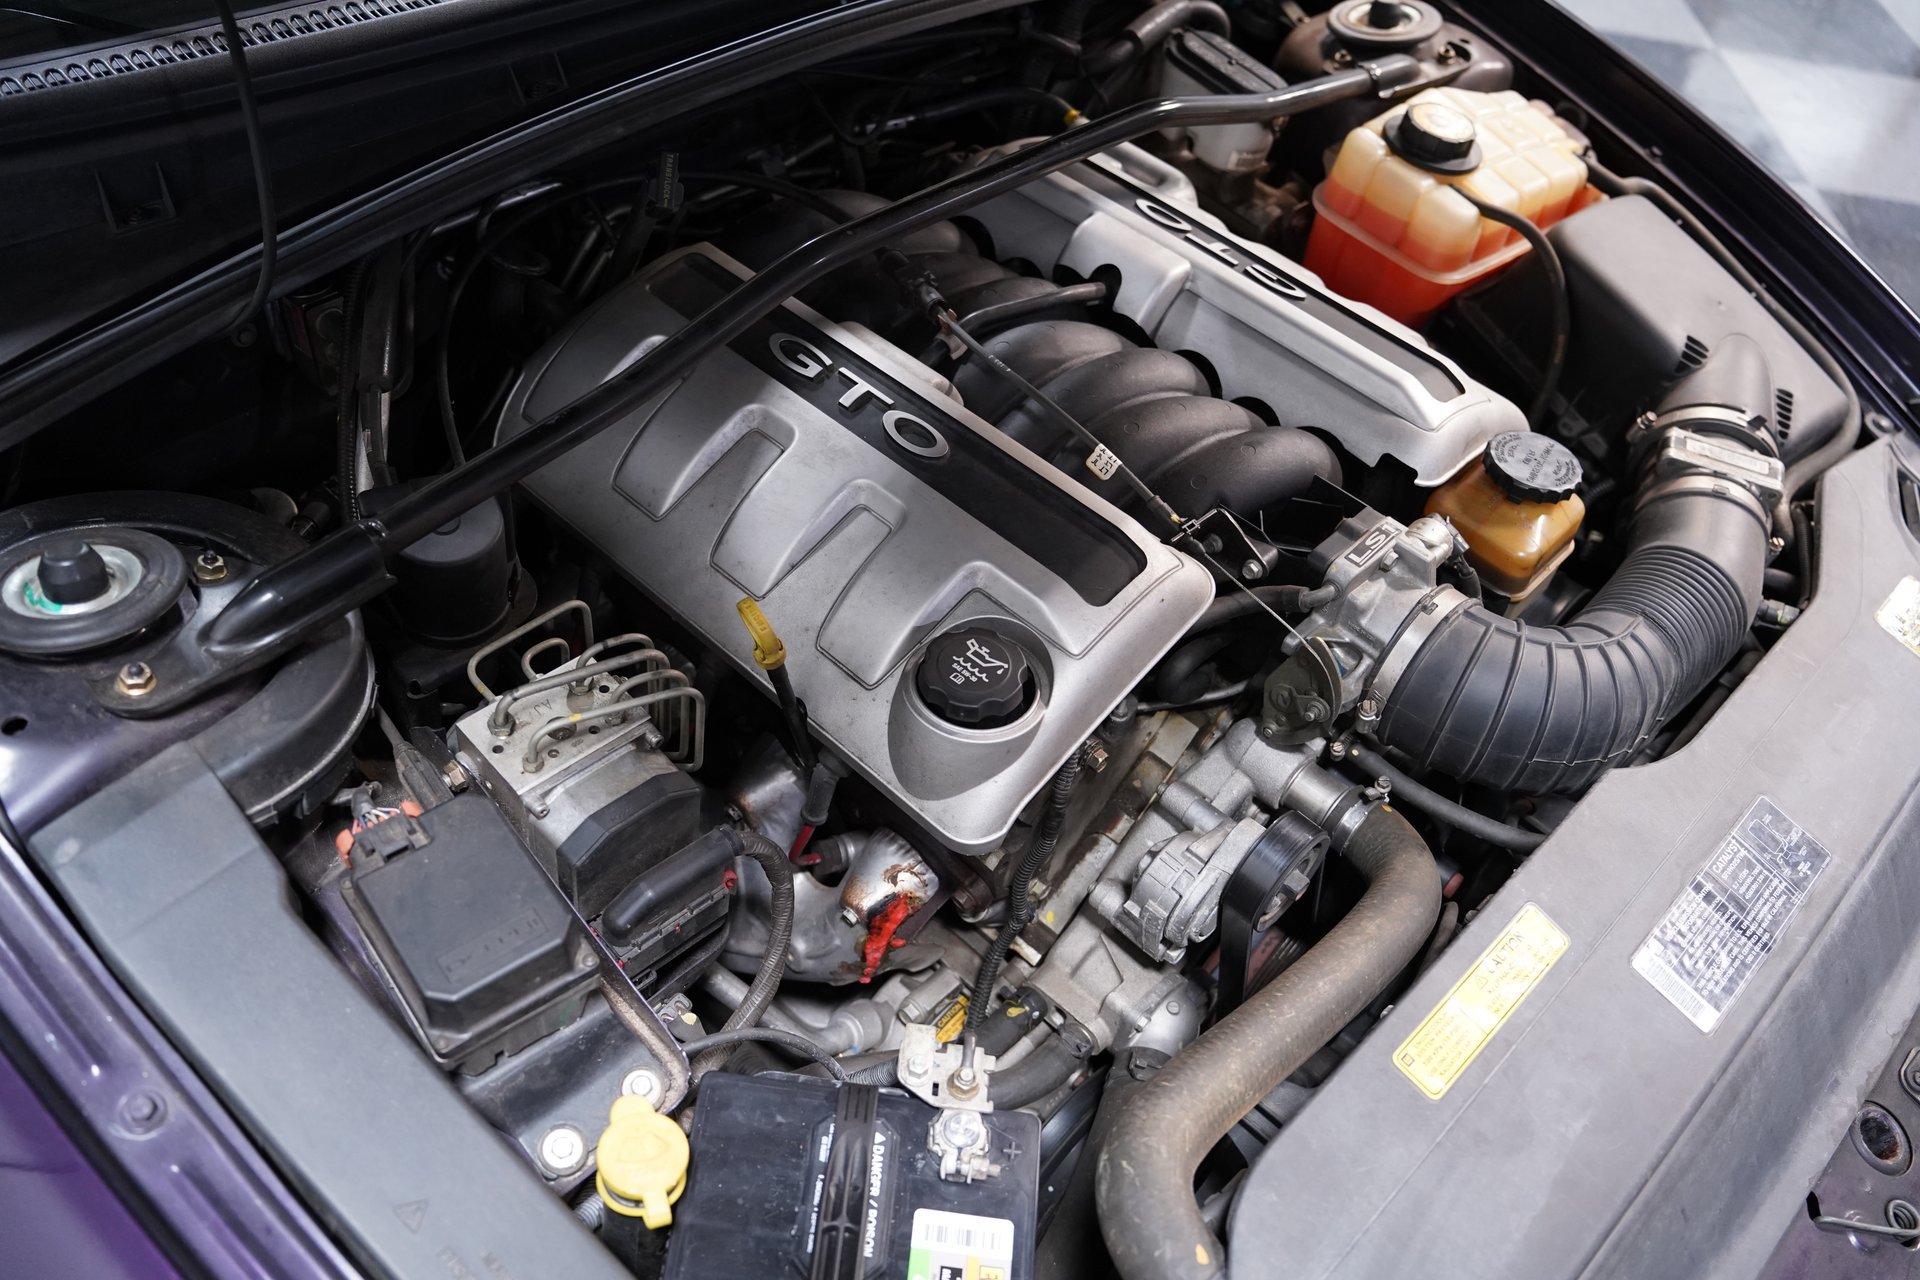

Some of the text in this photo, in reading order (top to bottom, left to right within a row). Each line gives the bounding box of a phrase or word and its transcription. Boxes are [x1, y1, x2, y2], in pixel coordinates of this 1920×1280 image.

[1136, 199, 1307, 298] GTO
[769, 332, 949, 458] GTO
[1348, 524, 1398, 564] LS1
[951, 661, 977, 682] SAE 5W-30
[1711, 838, 1740, 874] CATALYST
[938, 1002, 962, 1028] CAUTION
[869, 1145, 885, 1197] DANGER
[863, 1209, 878, 1258] POISON
